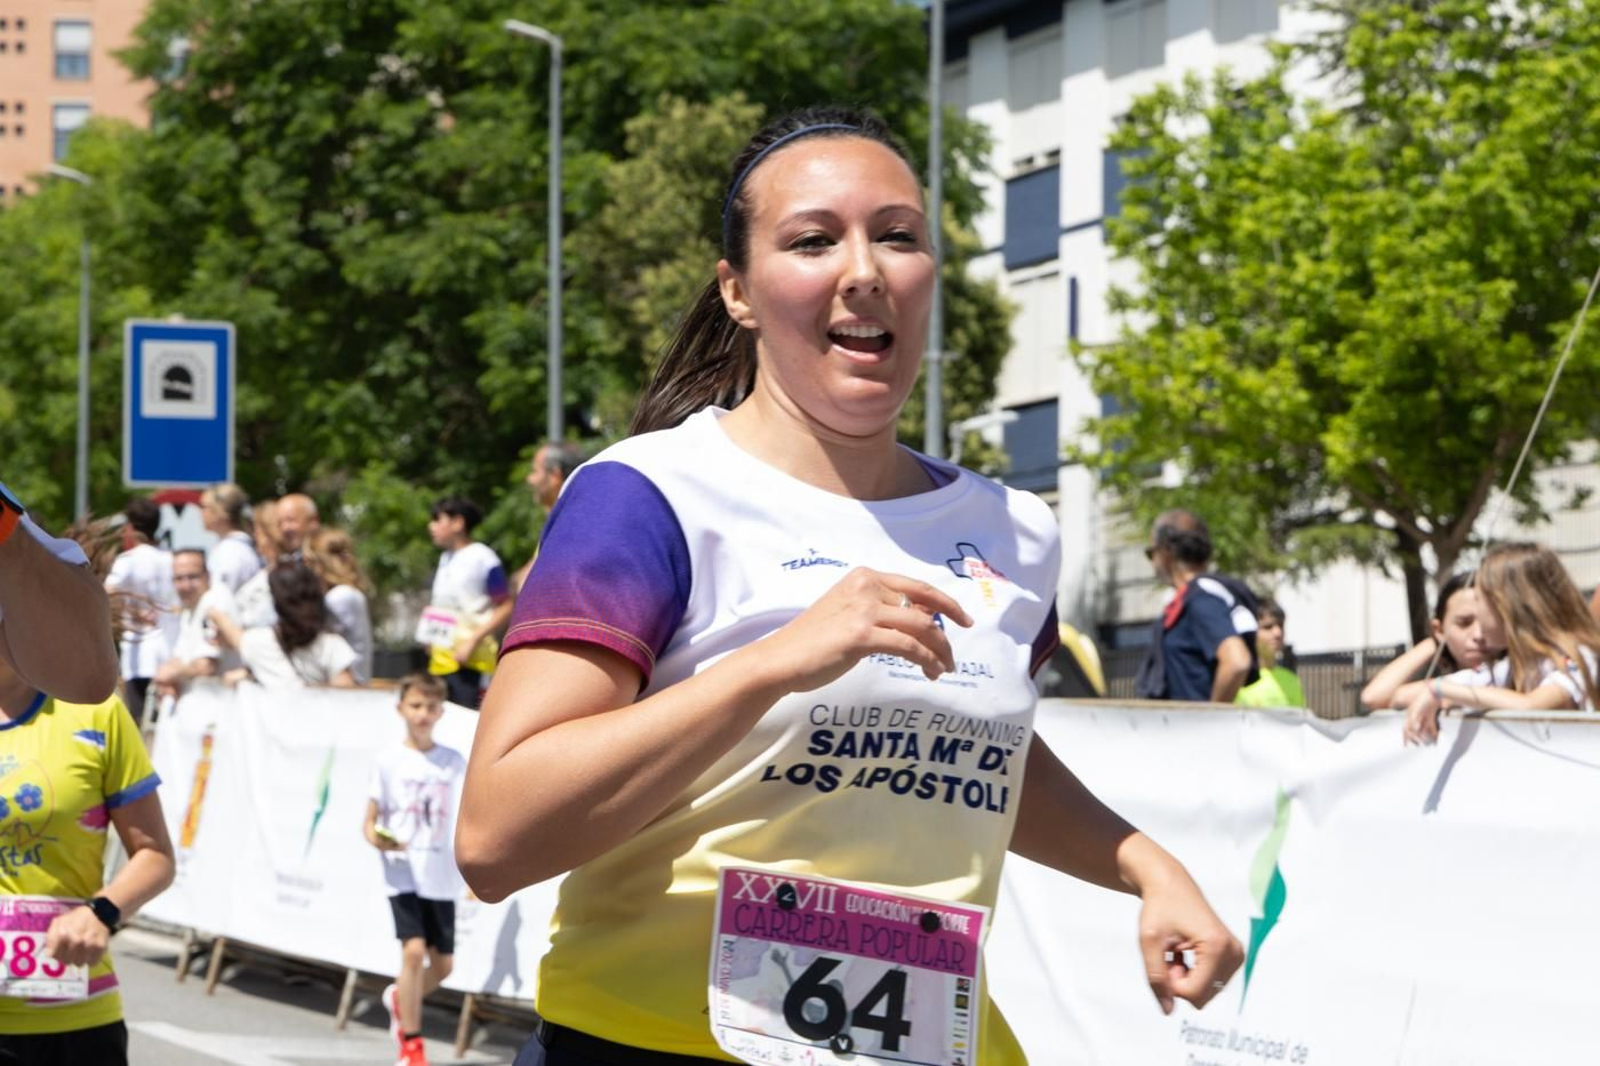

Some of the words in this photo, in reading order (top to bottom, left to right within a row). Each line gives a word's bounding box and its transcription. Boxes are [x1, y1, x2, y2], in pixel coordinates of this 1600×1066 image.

[810, 704, 880, 727] CLUB
[888, 708, 922, 728] DE
[927, 713, 1025, 746] RUNNING
[808, 730, 920, 760] SANTA
[929, 736, 974, 764] Mª
[760, 763, 843, 792] LOS
[734, 903, 850, 950] CARRERA
[858, 923, 966, 972] POPULAR
[783, 957, 911, 1052] 64
